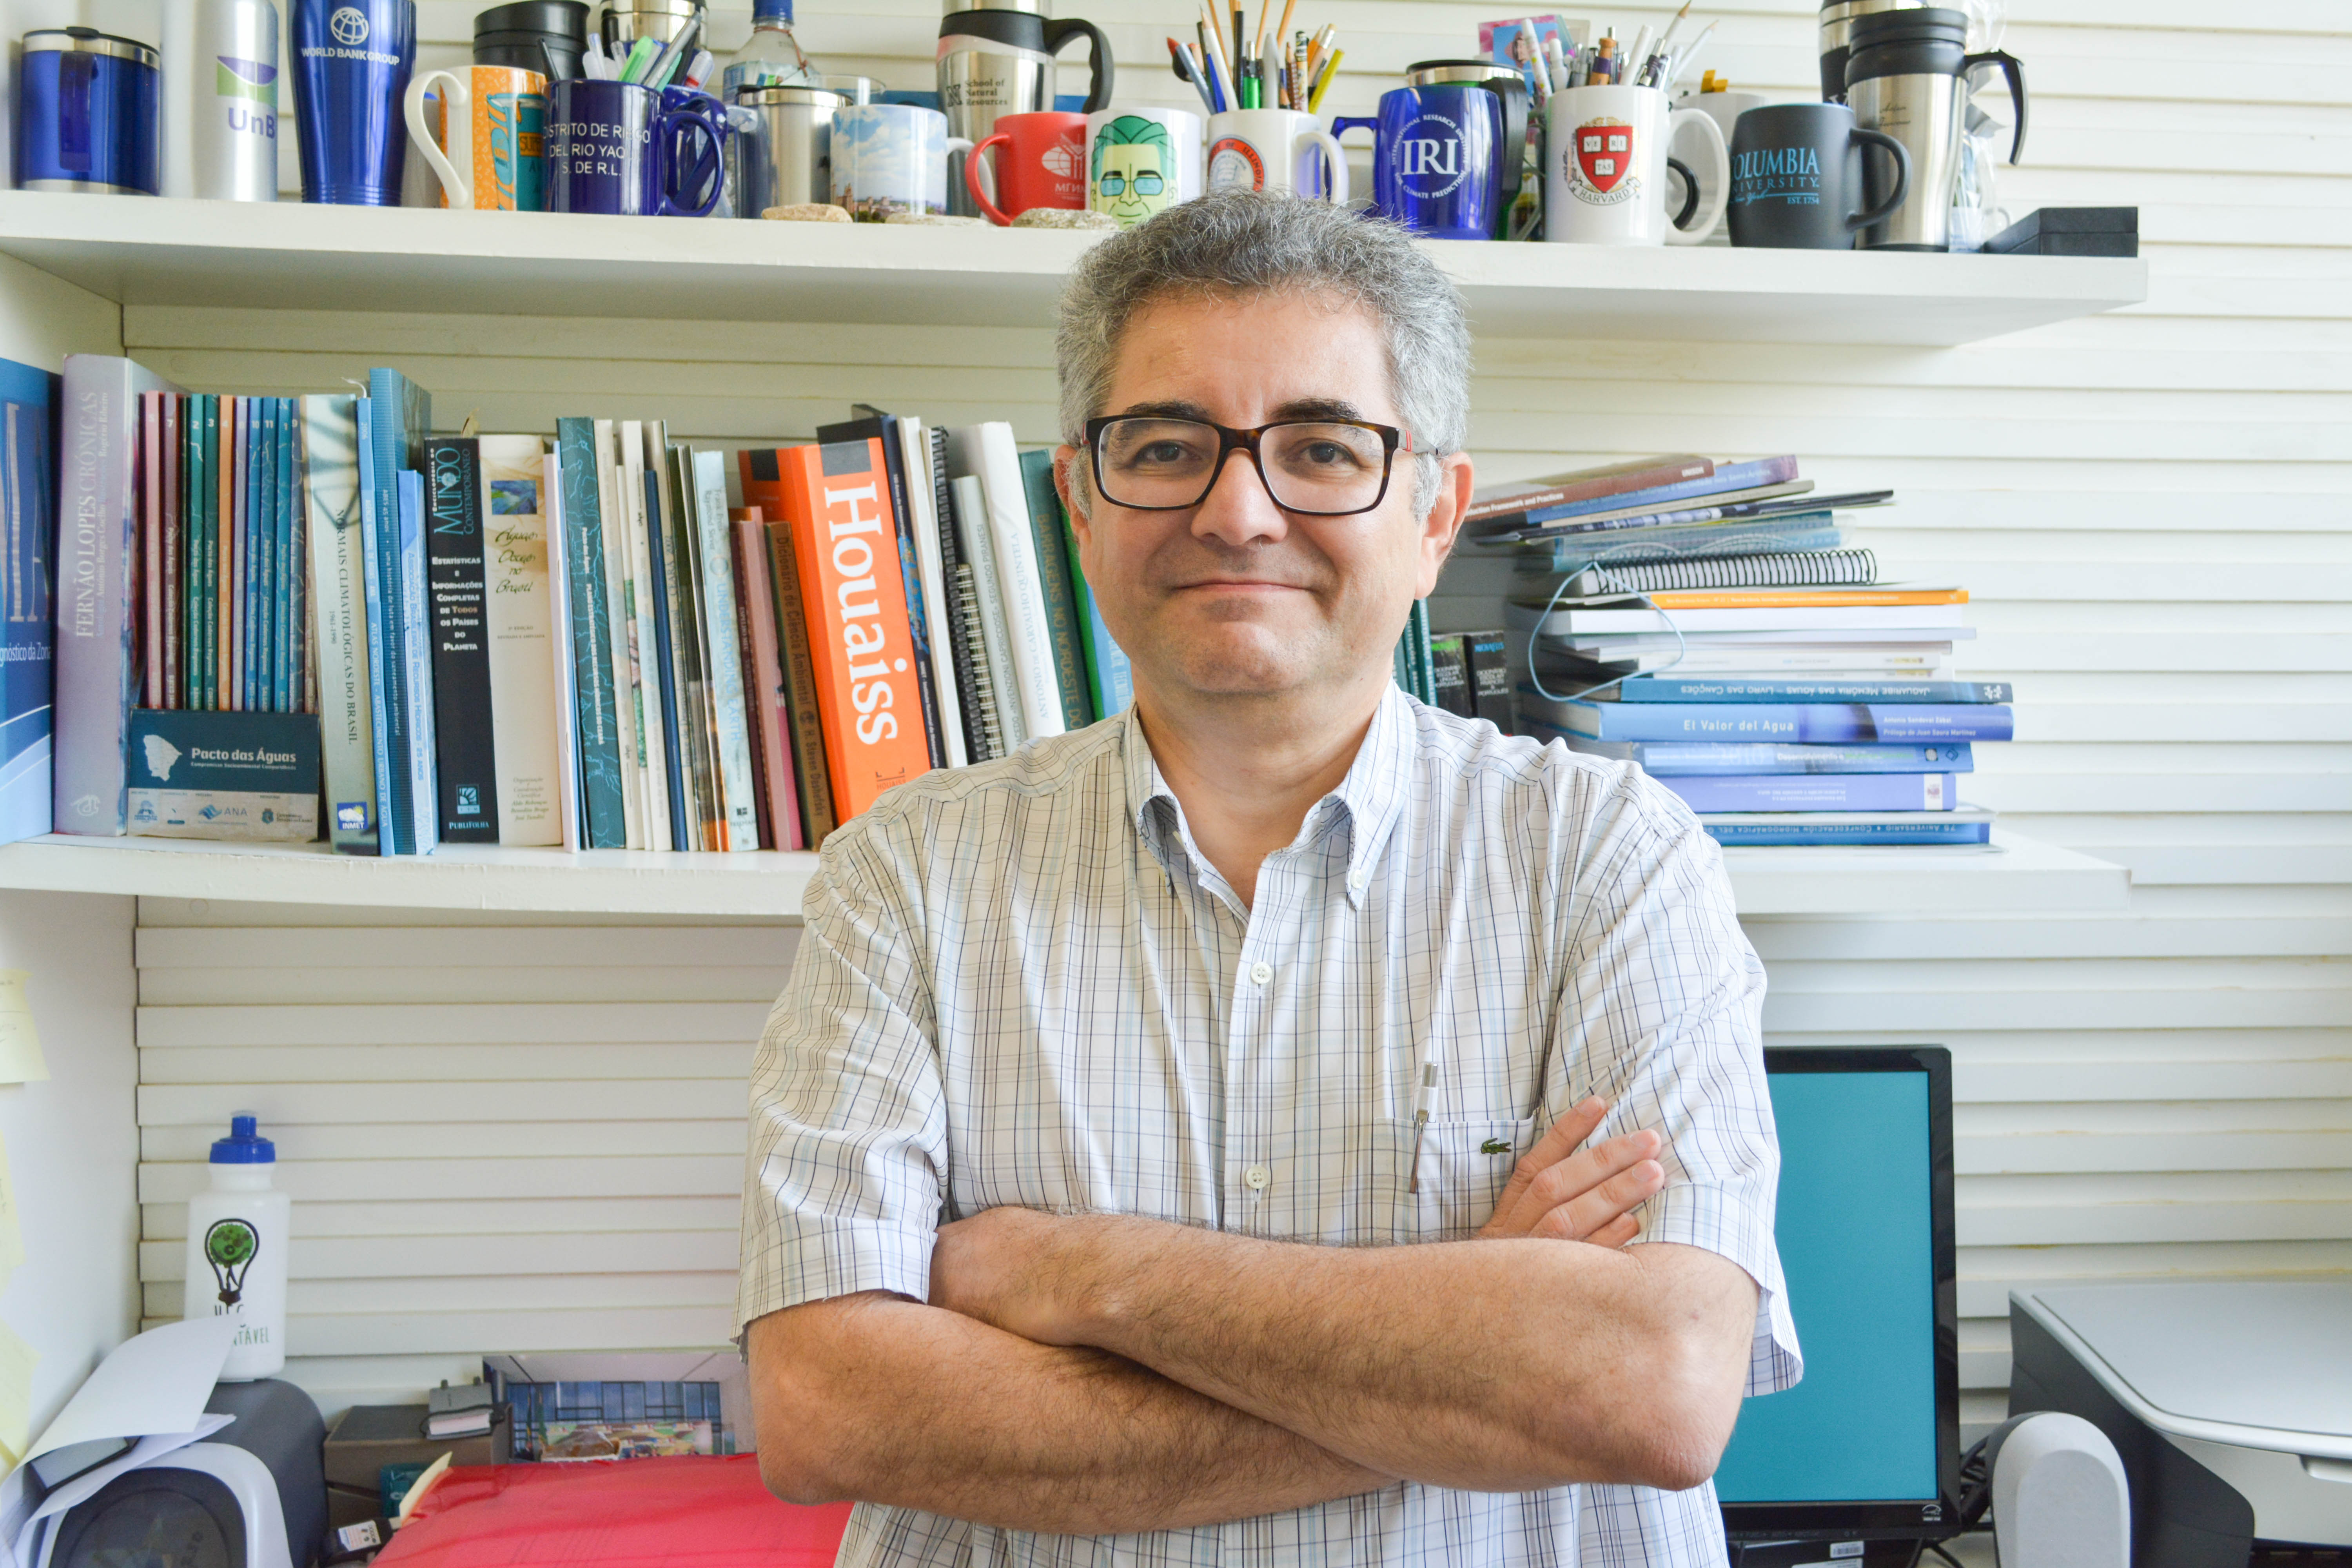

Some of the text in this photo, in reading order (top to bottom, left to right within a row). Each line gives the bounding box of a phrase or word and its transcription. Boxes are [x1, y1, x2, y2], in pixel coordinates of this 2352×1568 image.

[302, 47, 400, 66] WORLD BANK GROUP
[228, 107, 275, 139] UnB
[591, 123, 609, 138] DE
[550, 143, 595, 157] DEL RIO
[1401, 138, 1459, 175] IRI
[575, 162, 593, 174] DE
[597, 162, 622, 177] R.L.
[1733, 147, 1820, 181] OLUMBIA
[1432, 169, 1467, 199] PREDICTION
[1579, 189, 1629, 203] HARVARD
[167, 419, 174, 428] 7
[192, 421, 199, 429] 2
[208, 419, 214, 427] 3
[265, 420, 274, 428] 11
[433, 447, 464, 535] MUNDO
[461, 448, 474, 535] CONTEMPORÂNEO
[73, 392, 98, 637] FERNÃO LOPES CRÓNICAS
[97, 505, 107, 533] Coelho
[704, 490, 713, 526] Raymond
[495, 524, 538, 548] Águas
[976, 524, 990, 562] PIRANESI
[97, 535, 108, 563] Borges
[1036, 515, 1063, 603] BARRAGENS
[432, 556, 481, 565] ESTATÍSTICAS
[1010, 532, 1028, 591] QUINTELA
[97, 565, 105, 598] António
[432, 581, 483, 591] INFORMAÇÕES
[495, 579, 534, 594] Brasil
[984, 564, 998, 604] SEGUNDO
[436, 593, 480, 602] COMPLETAS
[452, 617, 479, 626] PAÍSES
[777, 537, 810, 704] Dicionário de Ciência Ambiental
[824, 481, 907, 745] Houaiss
[1020, 592, 1037, 652] CARVALHO
[1052, 606, 1067, 628] NO
[335, 510, 358, 744] NORMAIS CLIMATOLÓGICAS DO BRASIL
[28, 641, 36, 661] da
[443, 642, 478, 651] PLANETA
[372, 647, 380, 685] NORDESTE
[716, 583, 741, 739] UNDERSTANDING EARTH
[1056, 631, 1080, 705] NORDESTE
[1681, 683, 1930, 697] JAGUARIBE MEMÓRIA DAS ÁGUAS LIVRO DAS CANÇÕES
[374, 695, 384, 755] ABASTECIMENTO
[1068, 708, 1083, 729] DO
[1684, 719, 1795, 734] El Valor del Agua
[191, 747, 296, 764] Pacto das Águas
[416, 748, 423, 758] 25
[806, 742, 818, 771] Steven
[379, 792, 386, 802] DE
[224, 807, 247, 816] ANA
[380, 805, 389, 827] ÁGUA
[342, 822, 365, 830] INMET
[448, 821, 490, 830] PUBLIFOLHA
